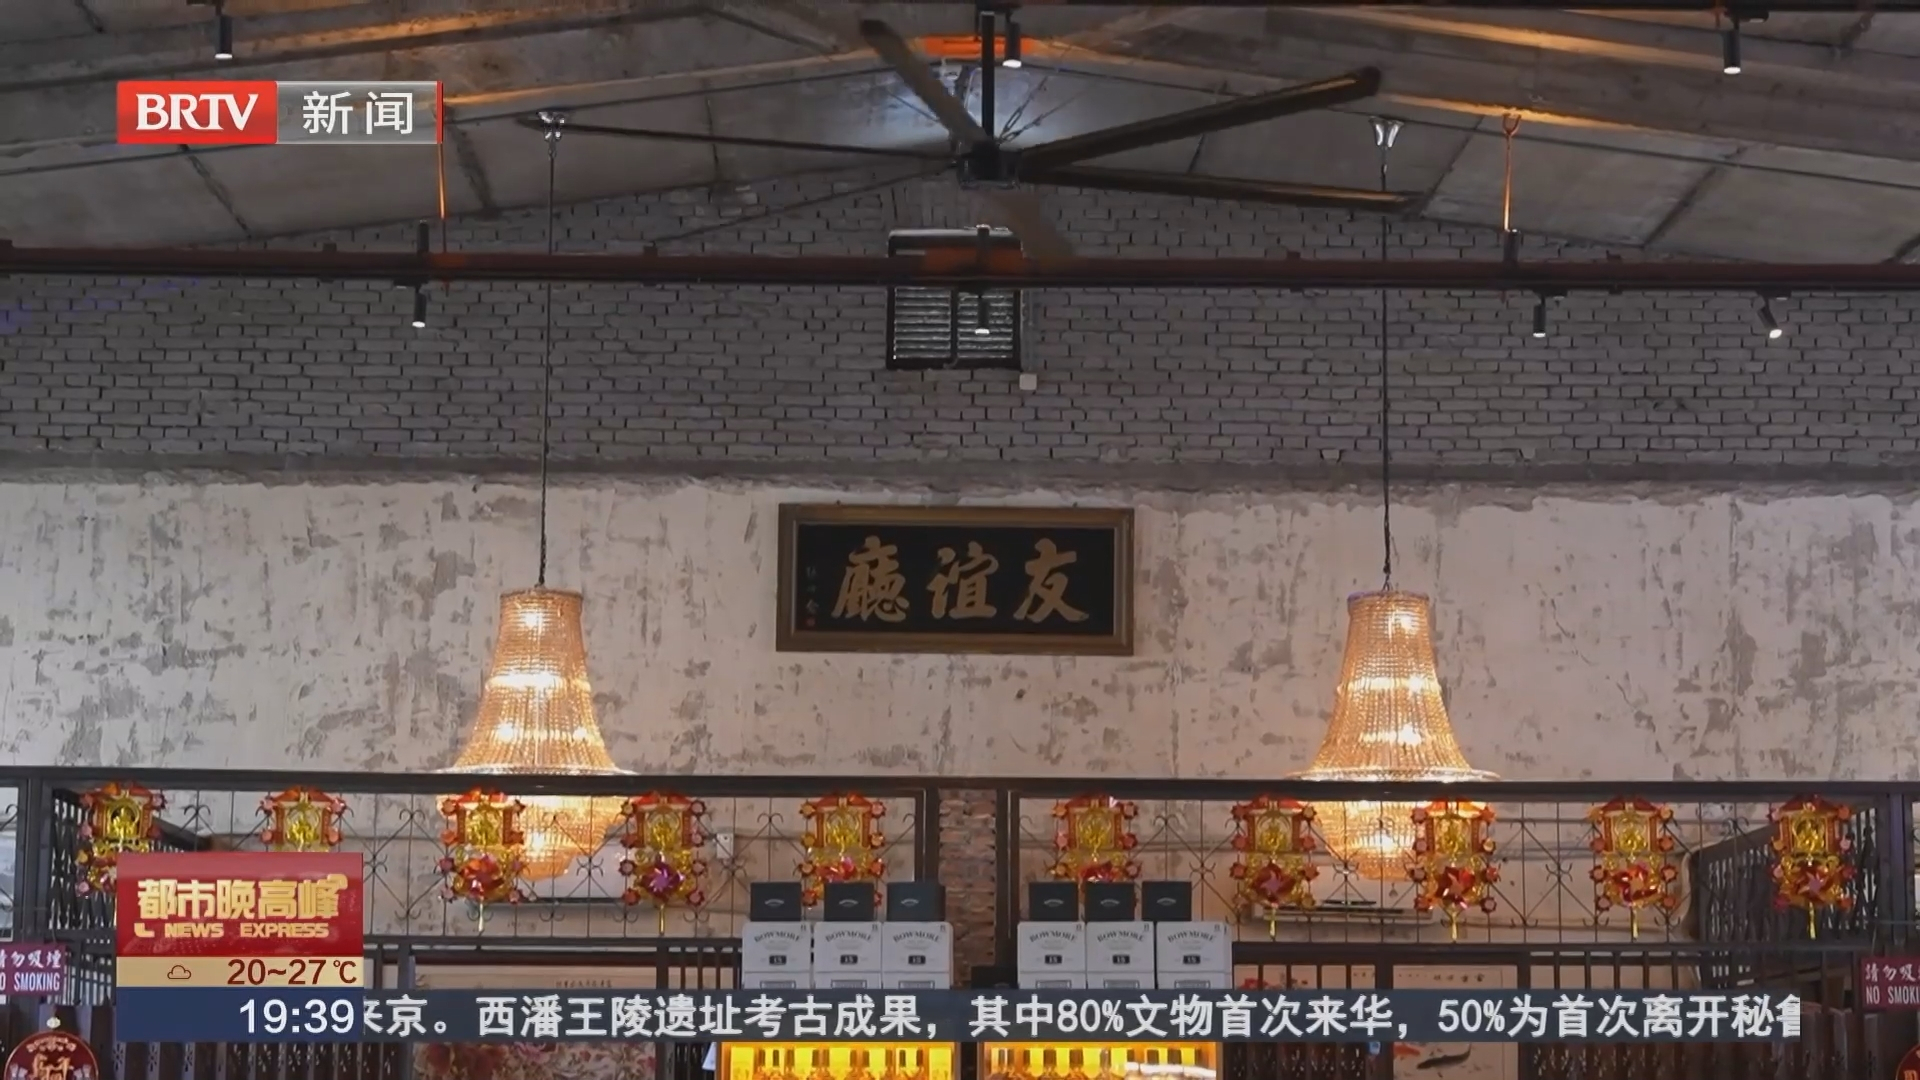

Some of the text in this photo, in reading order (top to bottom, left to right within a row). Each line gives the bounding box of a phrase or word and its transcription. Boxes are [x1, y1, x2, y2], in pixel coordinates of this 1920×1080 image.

[14, 972, 60, 991] SMOKING
[1865, 962, 1920, 982] 請勿吸
[1866, 985, 1880, 1005] NO
